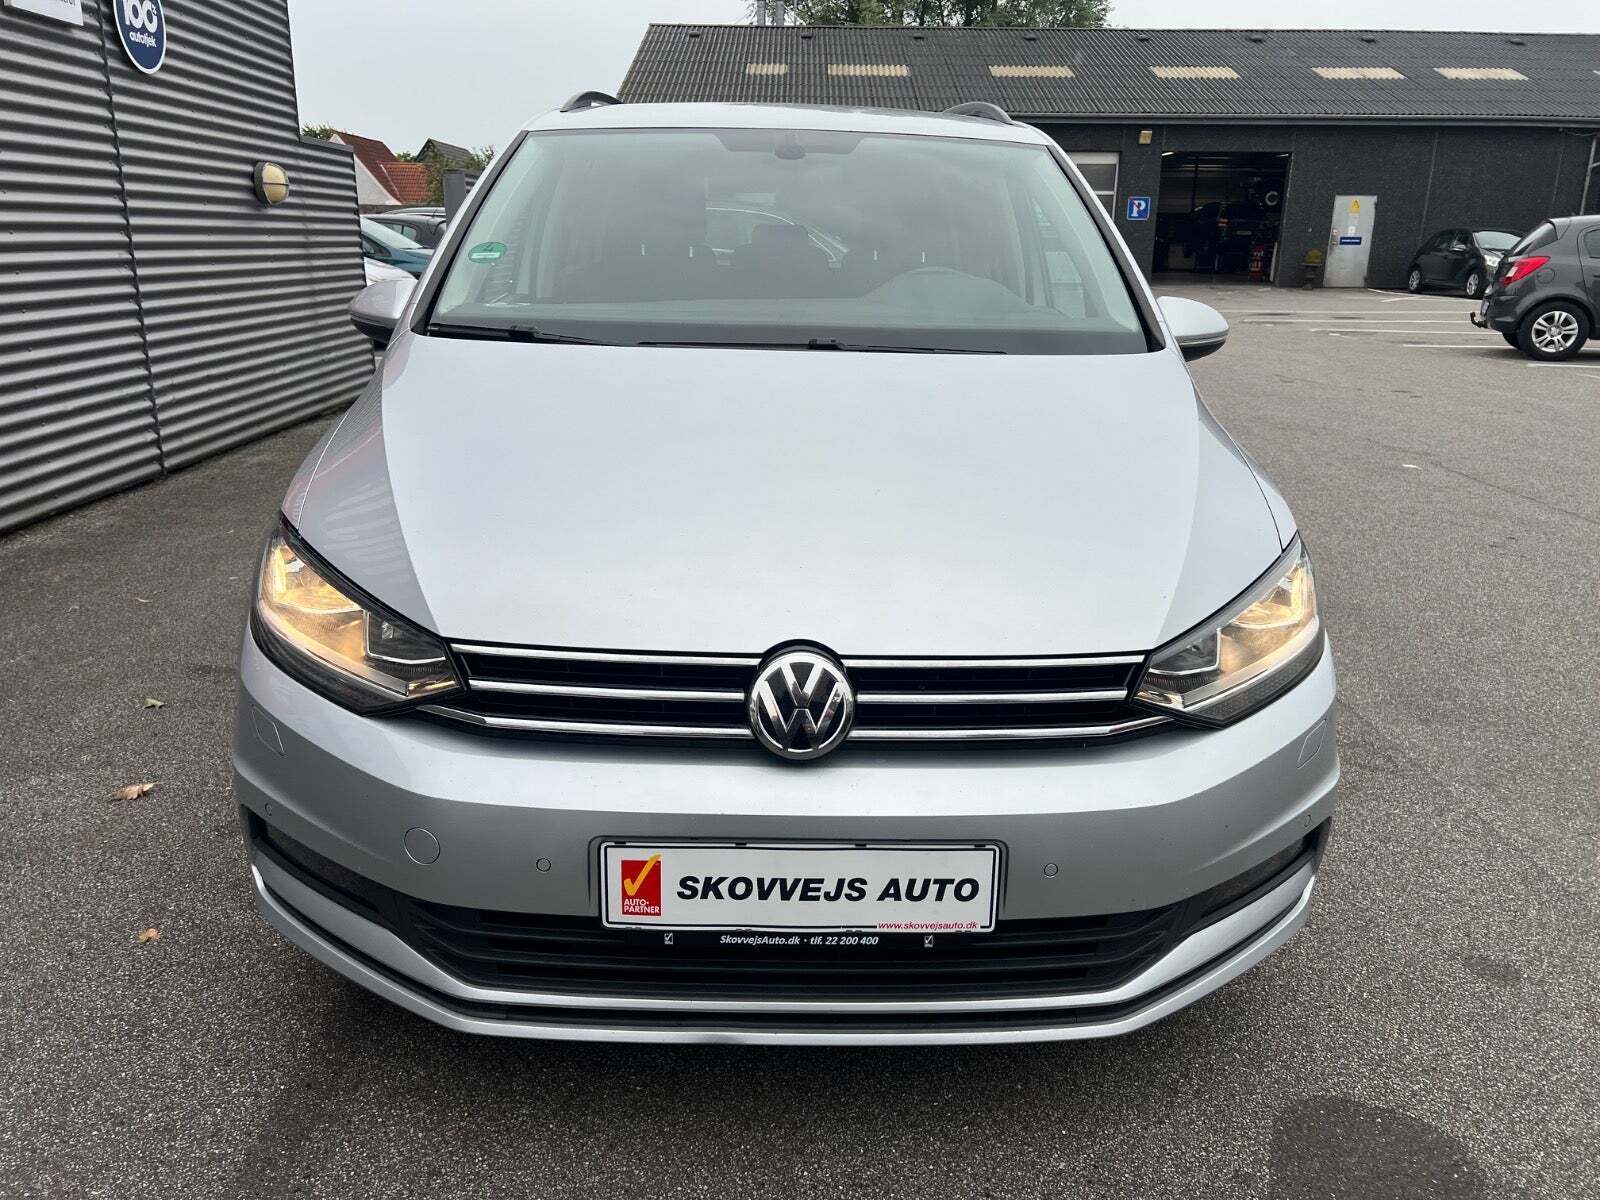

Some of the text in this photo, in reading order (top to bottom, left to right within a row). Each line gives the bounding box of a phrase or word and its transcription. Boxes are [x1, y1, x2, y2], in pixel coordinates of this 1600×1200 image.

[129, 31, 157, 48] autotjek
[1131, 199, 1146, 217] P
[676, 875, 980, 902] SKOVVEJS AUTO
[623, 905, 660, 914] PARTNER
[878, 921, 978, 930] www.skovvejsauto.dk
[719, 935, 879, 946] SkovvejsAuto.dk tlf. 22 200 400
